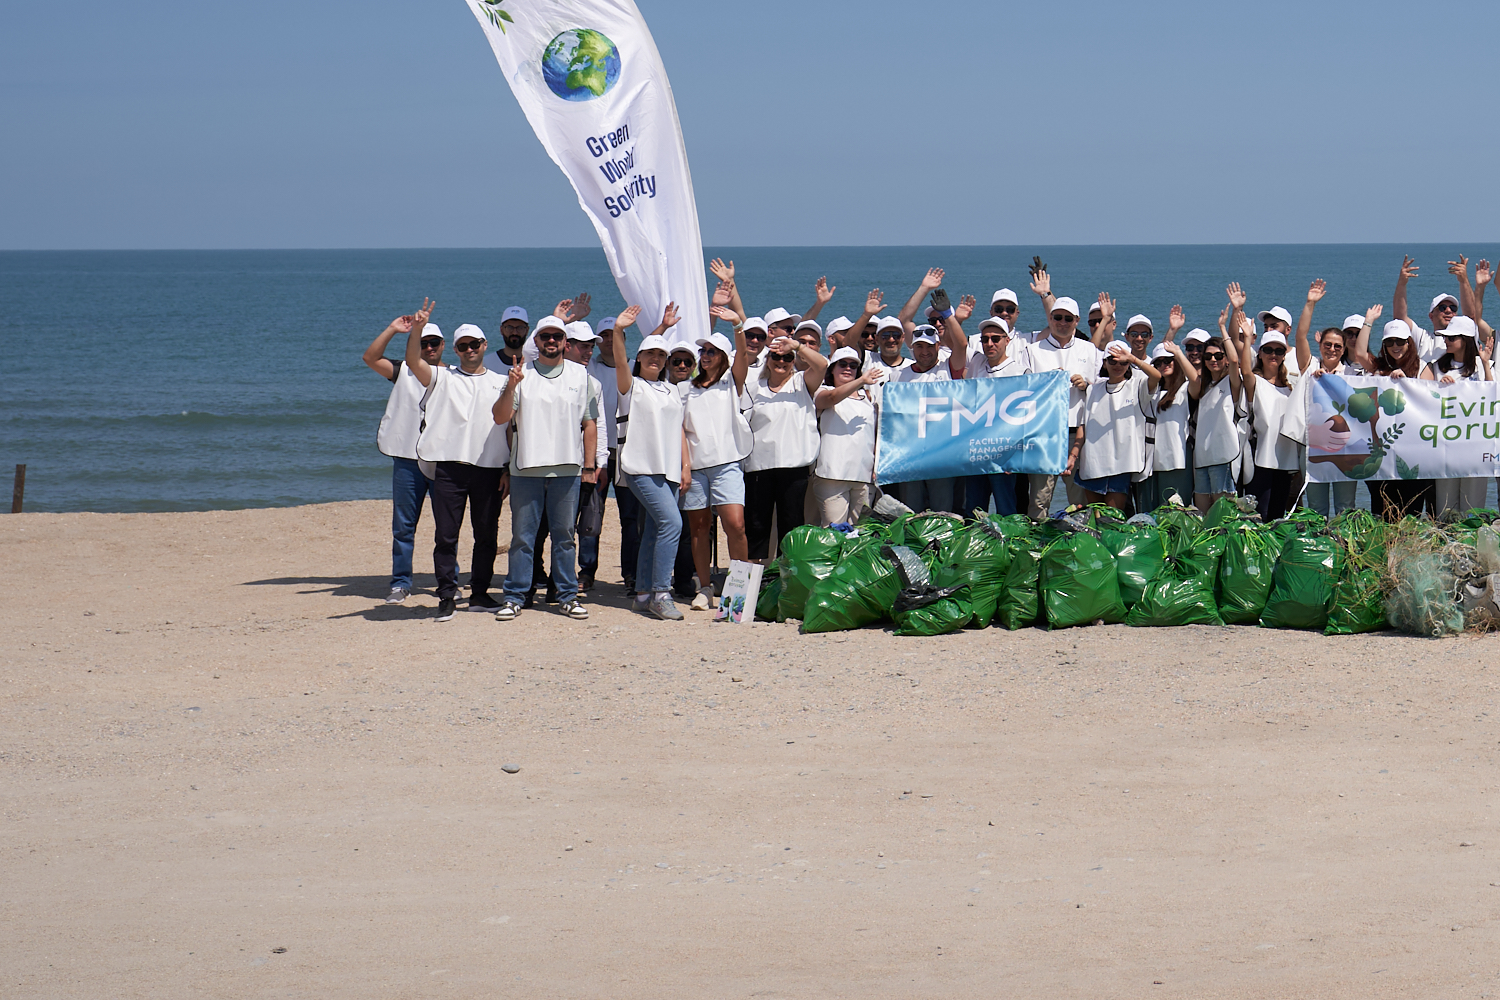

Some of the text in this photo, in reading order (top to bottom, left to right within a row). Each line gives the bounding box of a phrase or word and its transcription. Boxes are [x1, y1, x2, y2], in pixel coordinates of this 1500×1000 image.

[585, 124, 630, 158] Green
[917, 390, 1037, 439] FMG
[969, 437, 1012, 446] FACILITY
[969, 443, 1035, 455] MANAGEMENT
[969, 453, 1003, 463] GROUP
